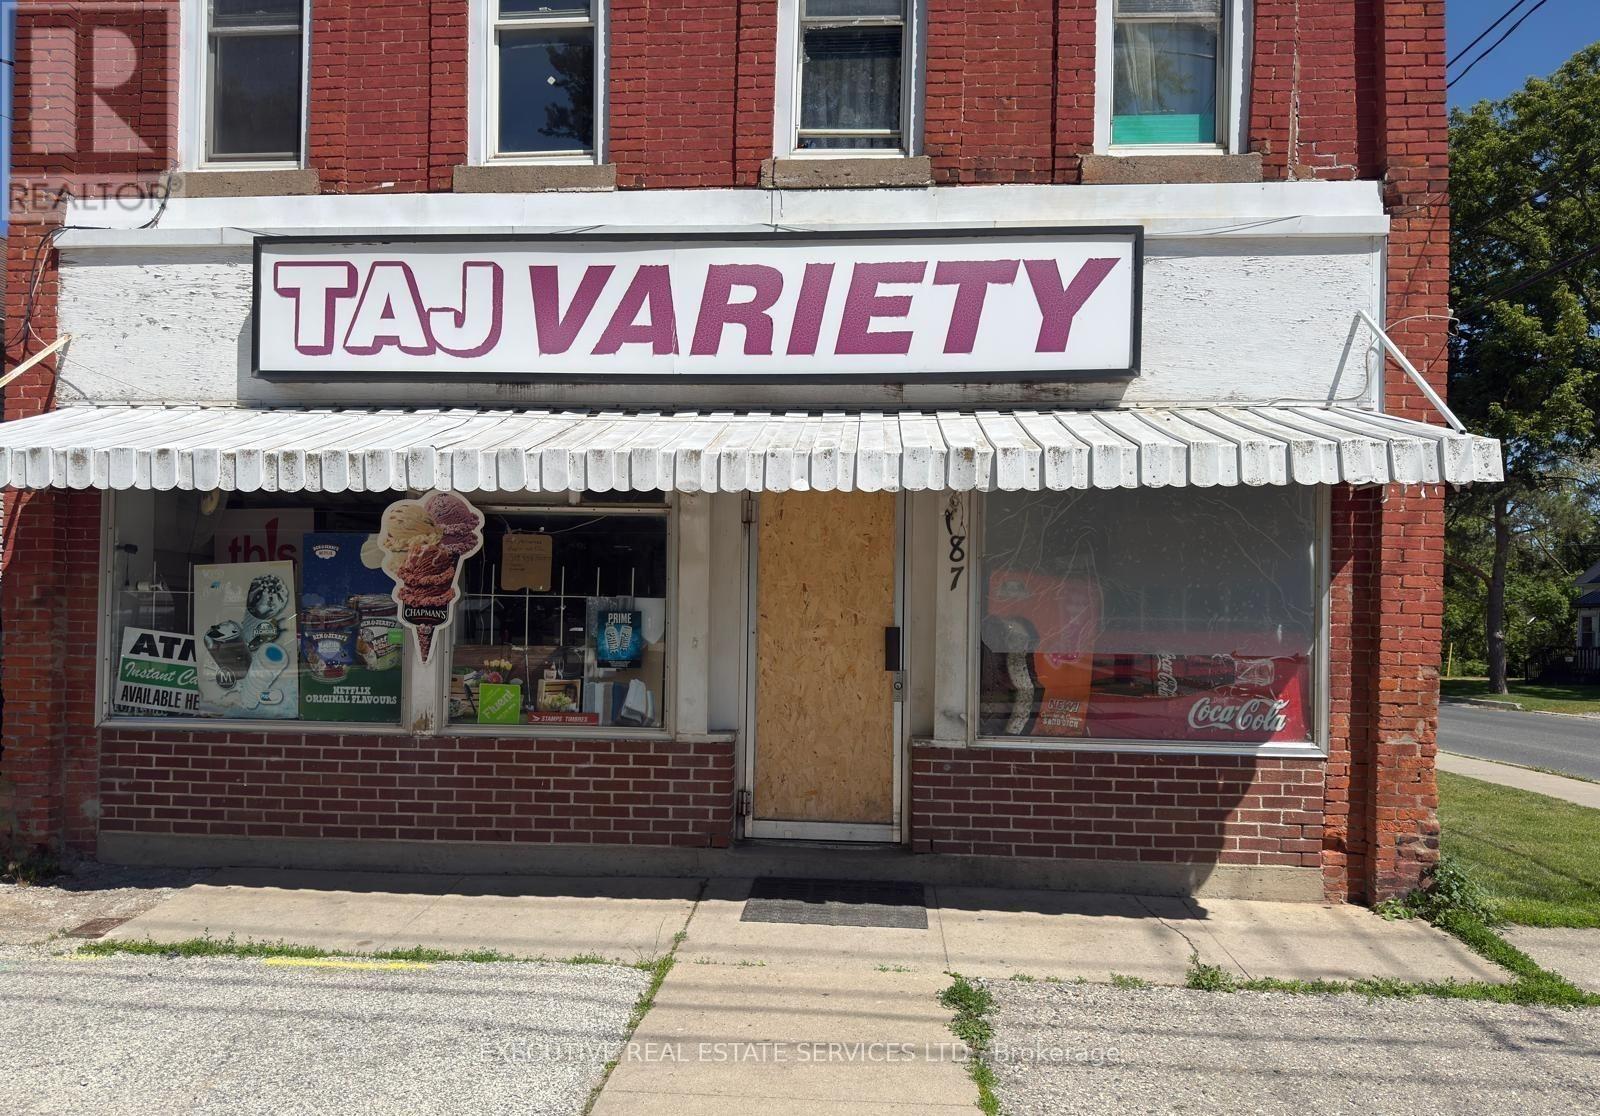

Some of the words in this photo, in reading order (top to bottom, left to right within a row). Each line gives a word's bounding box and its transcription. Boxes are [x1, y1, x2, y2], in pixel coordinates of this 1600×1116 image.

[273, 260, 503, 358] TAJ
[528, 257, 1122, 356] VARIETY
[405, 608, 447, 619] CHAPMAN'S
[608, 612, 632, 624] PRIME
[125, 661, 176, 682] Instant
[121, 685, 182, 709] AVAILABLE
[332, 686, 371, 695] NETFLIX
[305, 694, 350, 703] ORIGINAL
[351, 695, 397, 704] FLAVOURS
[1187, 697, 1290, 732] Coca-Cola
